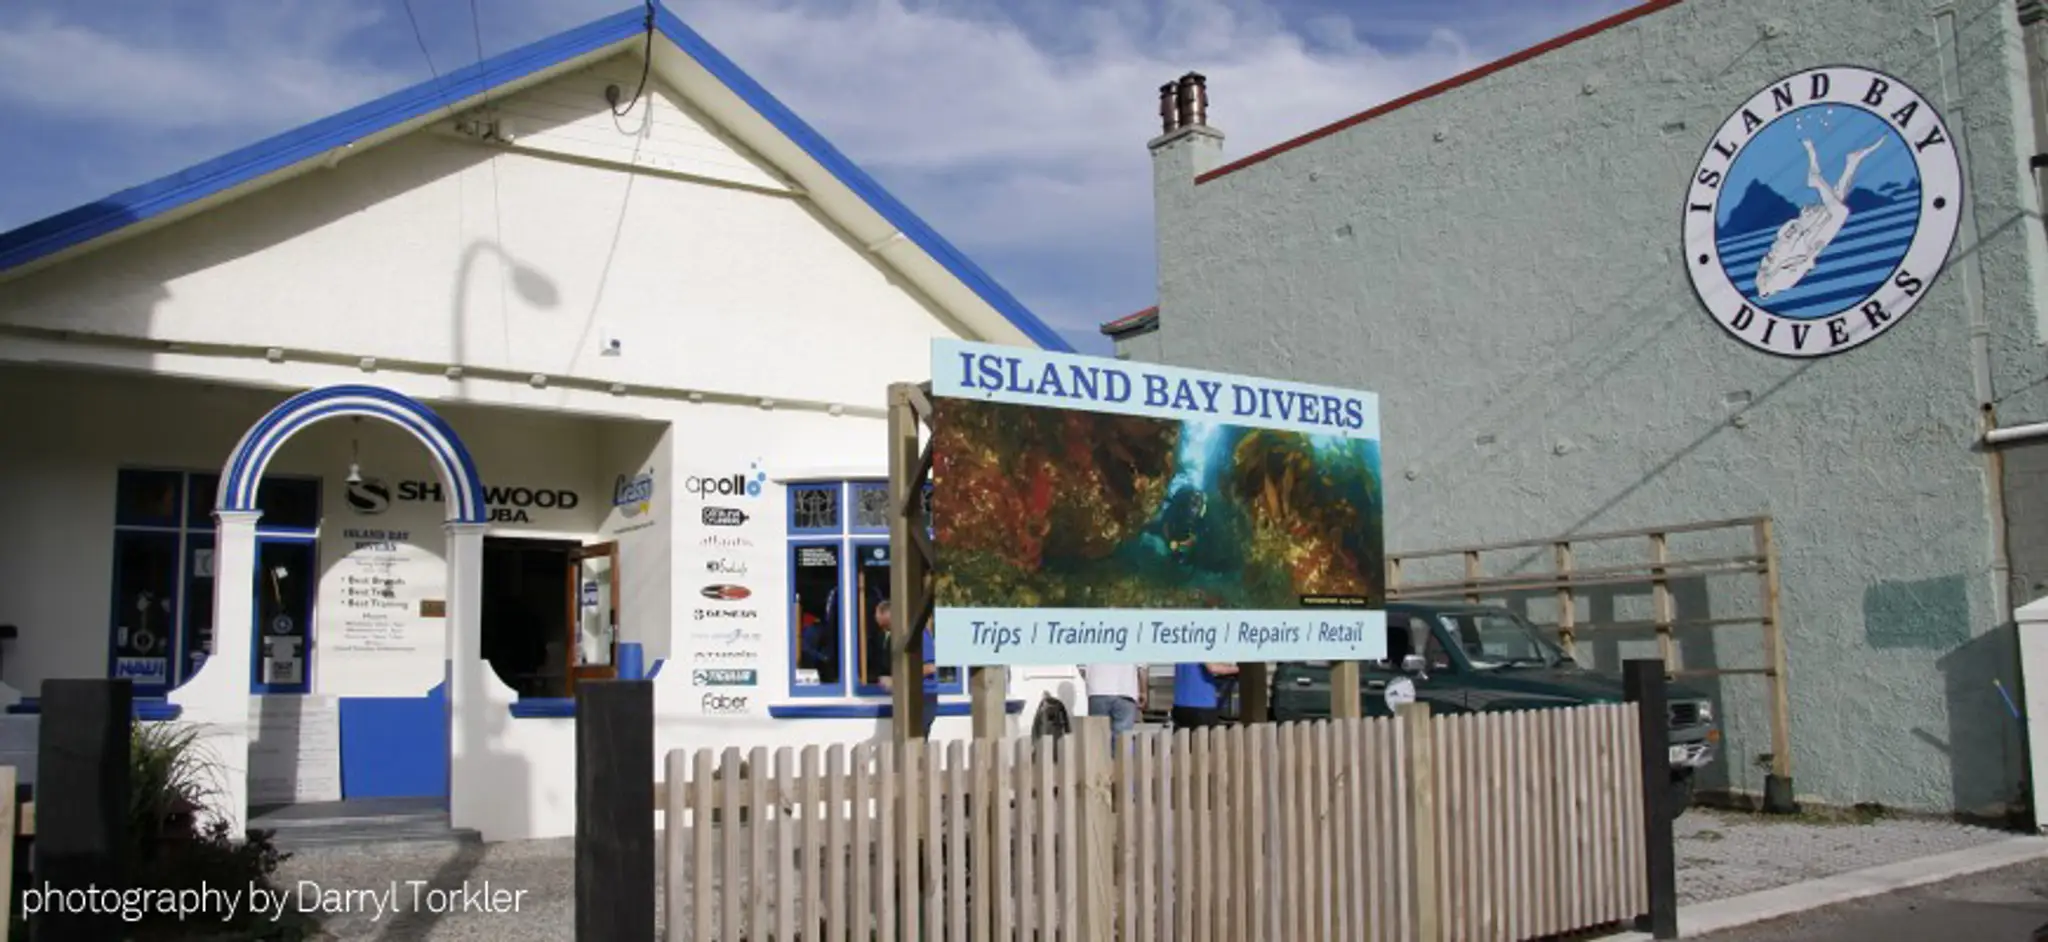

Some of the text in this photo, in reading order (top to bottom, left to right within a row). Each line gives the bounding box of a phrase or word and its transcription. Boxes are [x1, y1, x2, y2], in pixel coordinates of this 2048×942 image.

[1690, 73, 1945, 213] ISLAND BAY
[1730, 270, 1922, 350] DIVERS
[959, 351, 1363, 430] ISLAND BAY DIVERS
[397, 480, 578, 510] SHWOOD
[685, 474, 761, 500] apollo
[343, 529, 385, 539] ISLAND
[971, 621, 1021, 652] Trips
[1047, 621, 1128, 650] Training
[1151, 621, 1217, 650] Testing
[1238, 622, 1300, 649] Repairs
[1318, 621, 1363, 643] Retail
